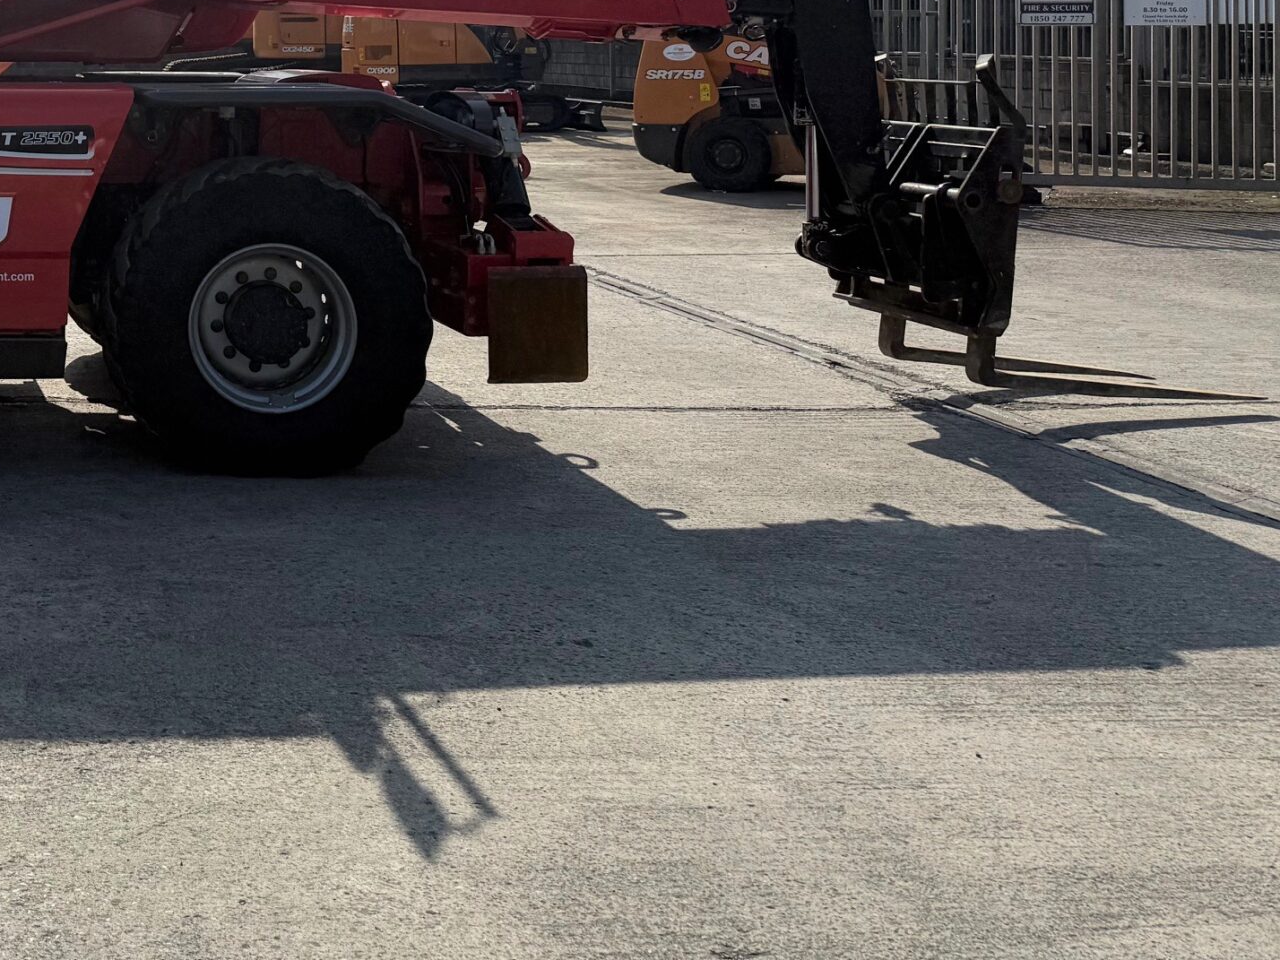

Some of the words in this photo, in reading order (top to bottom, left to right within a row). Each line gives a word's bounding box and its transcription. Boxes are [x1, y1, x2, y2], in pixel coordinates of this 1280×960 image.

[1024, 4, 1041, 12] FIRE
[1042, 4, 1050, 12] &
[1050, 4, 1090, 12] SECURITY
[725, 41, 769, 65] CA
[645, 69, 706, 80] SR175B
[20, 131, 88, 146] 2550+
